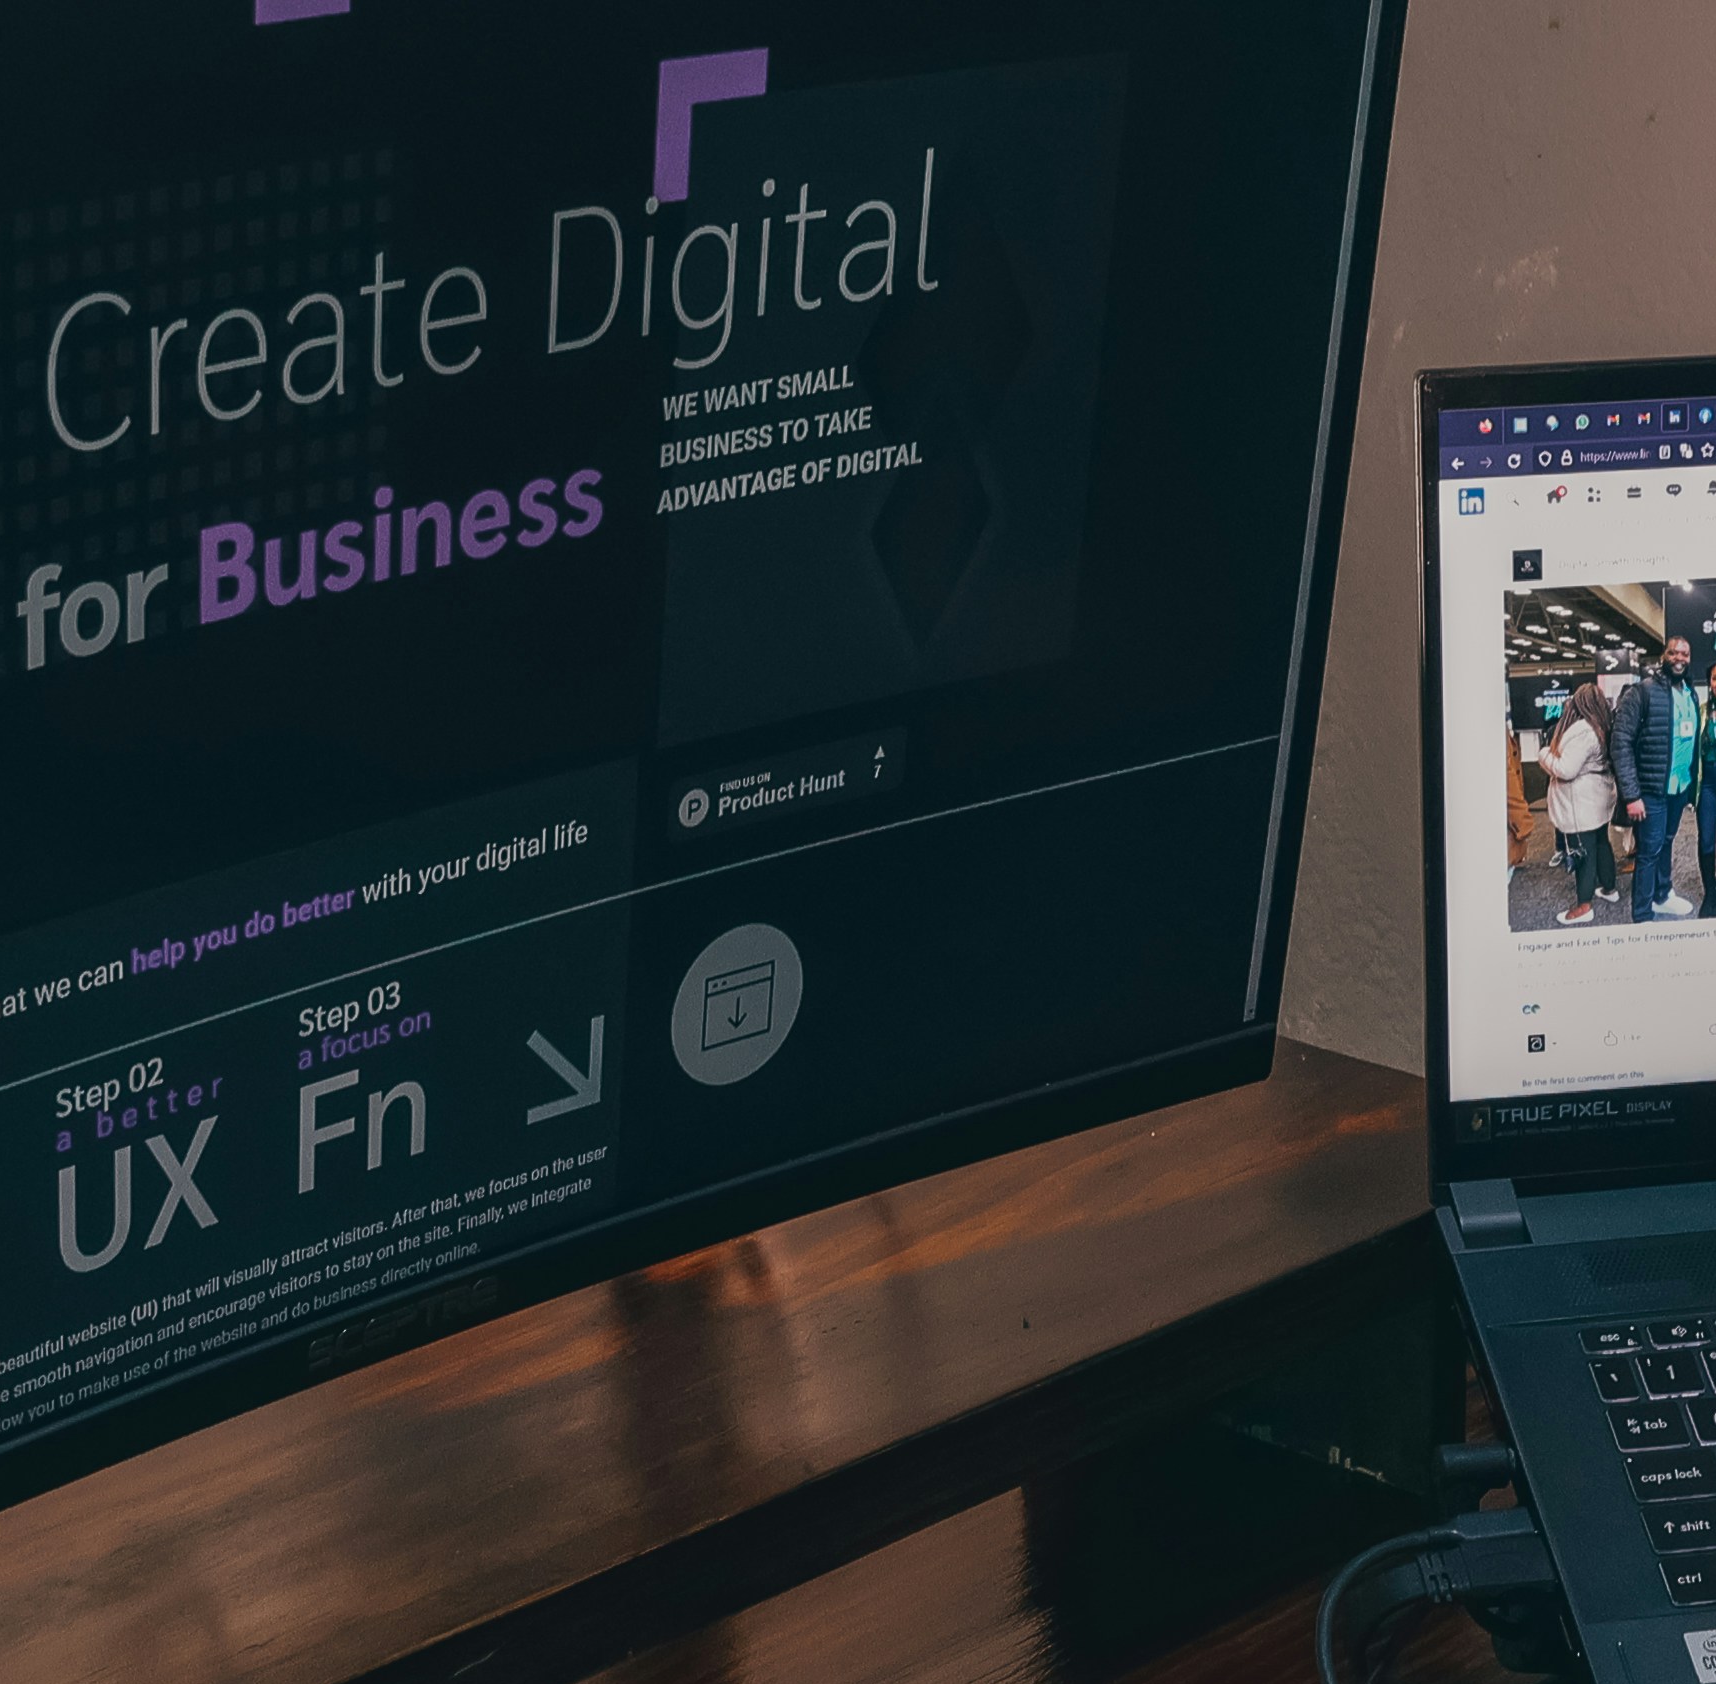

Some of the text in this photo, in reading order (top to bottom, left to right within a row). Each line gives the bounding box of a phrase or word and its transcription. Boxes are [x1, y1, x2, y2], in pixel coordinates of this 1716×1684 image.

[46, 253, 488, 453] Create
[546, 147, 940, 369] Digital
[663, 365, 855, 421] WE WANT SMALL
[659, 405, 873, 468] BUSINESS TO TAKE
[656, 441, 924, 515] ADVANTAGE OF DIGITAL
[17, 562, 169, 672] for
[196, 468, 605, 626] Business
[717, 769, 846, 817] Product Hunt
[719, 771, 772, 793] FIND US ON
[874, 764, 883, 779] 7
[33, 977, 71, 1007] we
[77, 960, 124, 992] can
[130, 937, 187, 975] help
[192, 924, 238, 962] you
[244, 910, 276, 939] do
[281, 889, 356, 928] better
[361, 867, 412, 905] with
[417, 855, 471, 895] your
[476, 827, 547, 872] digital
[554, 819, 588, 851] life
[298, 981, 402, 1038] Step 03
[298, 1011, 432, 1071] a focus on
[55, 1056, 165, 1118] Step 02
[56, 1076, 223, 1152] a better
[1495, 1100, 1673, 1124] TRUE PIXEL DISPLAY
[298, 1068, 427, 1194] Fn
[58, 1115, 220, 1273] UX
[67, 1314, 127, 1347] website
[130, 1298, 159, 1327] (UI)
[161, 1287, 192, 1312] that
[194, 1275, 220, 1299] will
[223, 1257, 278, 1288] visually
[281, 1237, 329, 1268] attract
[332, 1220, 388, 1249] visitors.
[391, 1205, 428, 1230] After
[430, 1193, 462, 1216] that,
[464, 1186, 486, 1203] we
[488, 1172, 528, 1196] focus
[531, 1165, 549, 1181] on
[552, 1157, 575, 1175] the
[577, 1145, 608, 1167] user
[1643, 1417, 1668, 1429] tab
[1640, 1466, 1703, 1484] caps lock
[1680, 1520, 1711, 1533] shift
